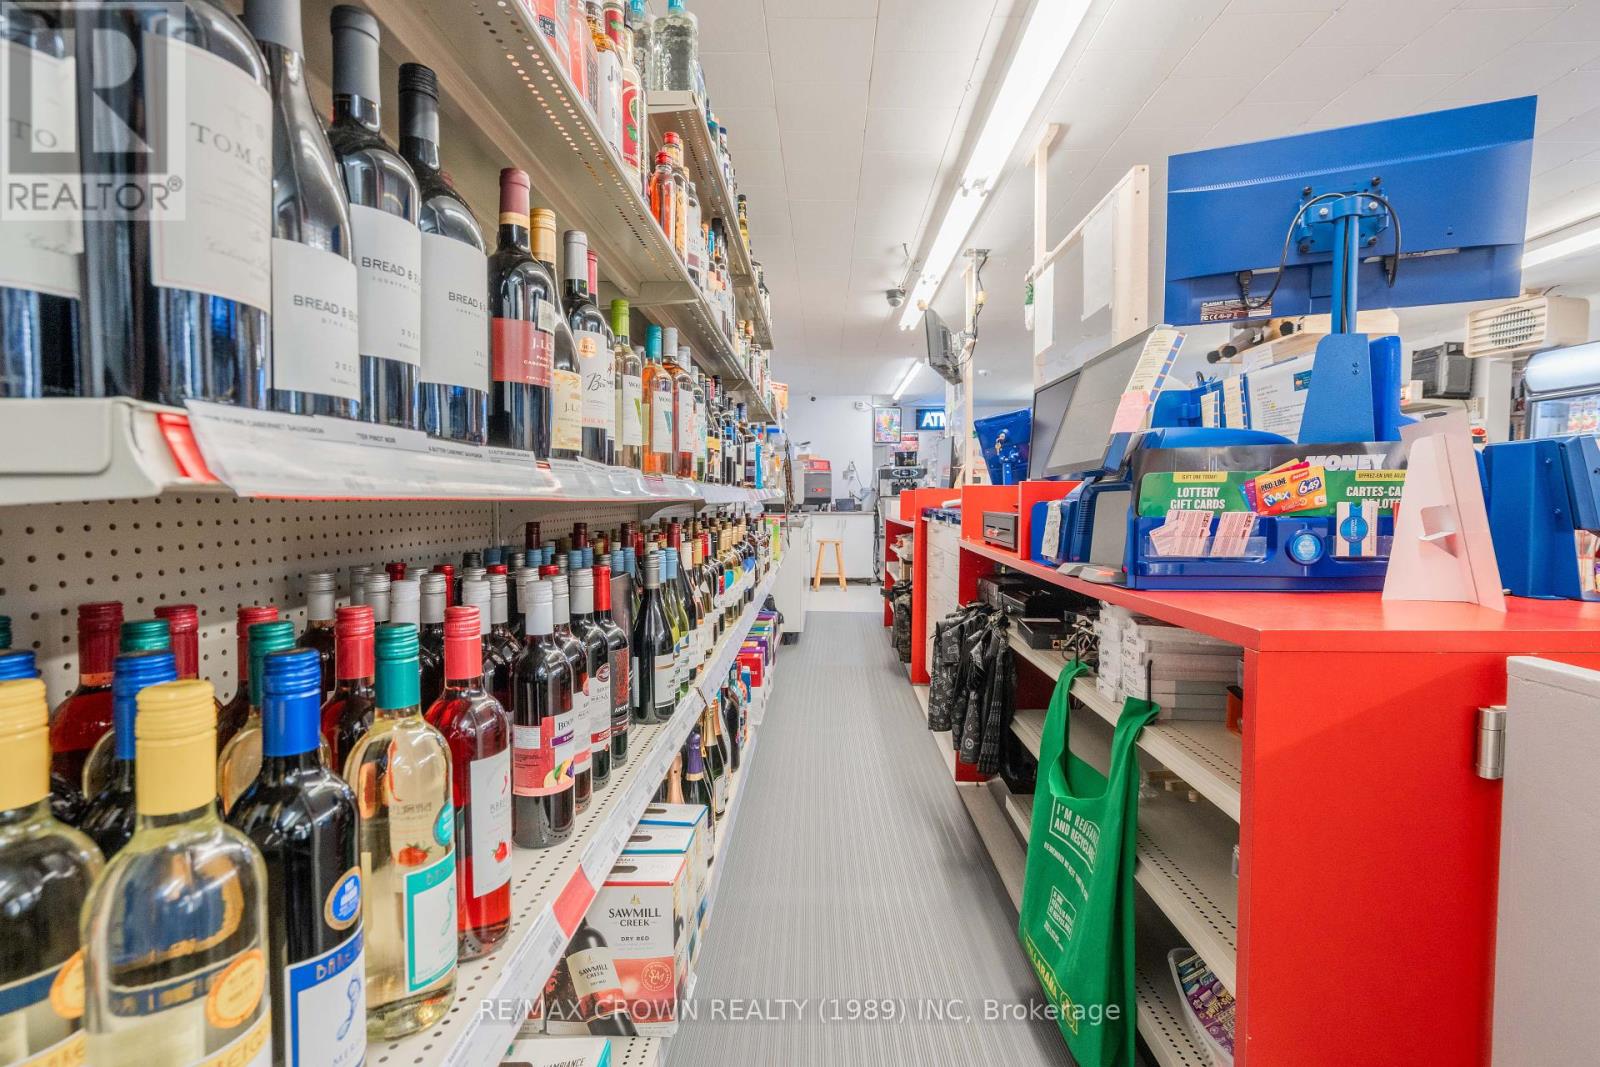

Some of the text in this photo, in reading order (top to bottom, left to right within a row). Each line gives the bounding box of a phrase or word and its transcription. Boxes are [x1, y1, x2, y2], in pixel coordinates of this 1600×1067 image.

[361, 256, 406, 277] BREAD
[293, 294, 340, 315] BREAD
[448, 291, 479, 308] BREAD
[1177, 487, 1220, 498] LOTTERY
[1170, 499, 1226, 510] GIFT CARDS
[1056, 803, 1072, 822] I'M
[1054, 817, 1071, 836] AND
[608, 907, 662, 919] SAWMILL
[620, 919, 650, 927] CREEK
[578, 964, 608, 977] SAWMILL
